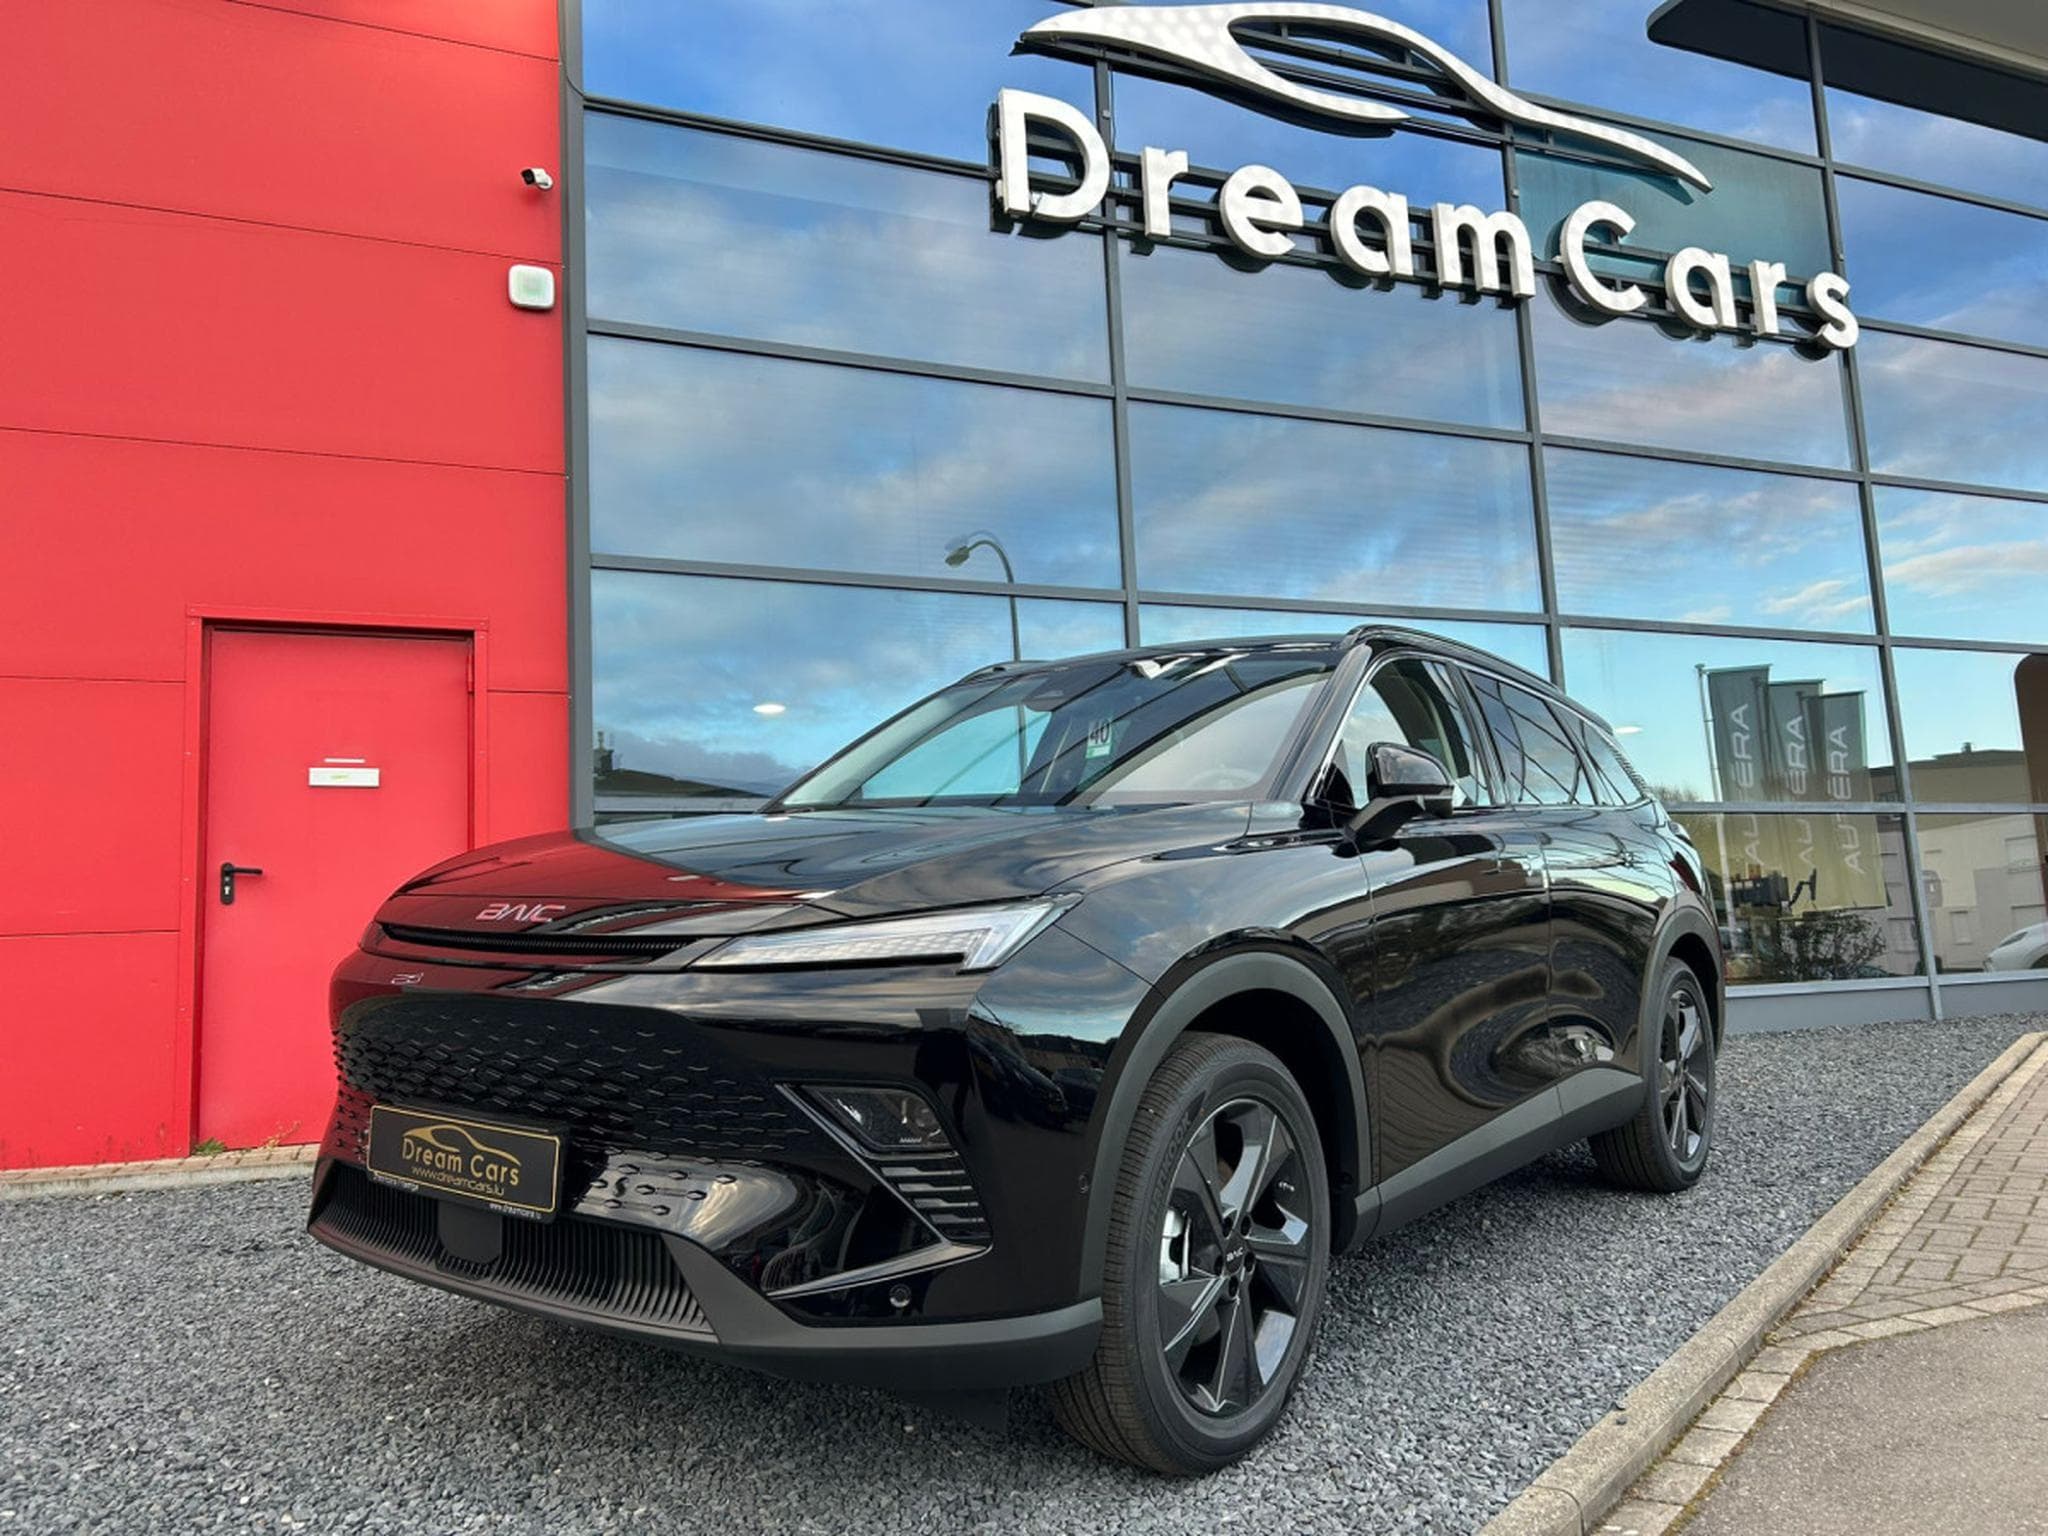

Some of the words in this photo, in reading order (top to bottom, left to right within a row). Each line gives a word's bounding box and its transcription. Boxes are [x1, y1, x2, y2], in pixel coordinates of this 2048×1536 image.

[995, 87, 1537, 300] Dream
[1557, 200, 1861, 352] Cars
[401, 1136, 463, 1174] Dream
[469, 1154, 520, 1187] Cars
